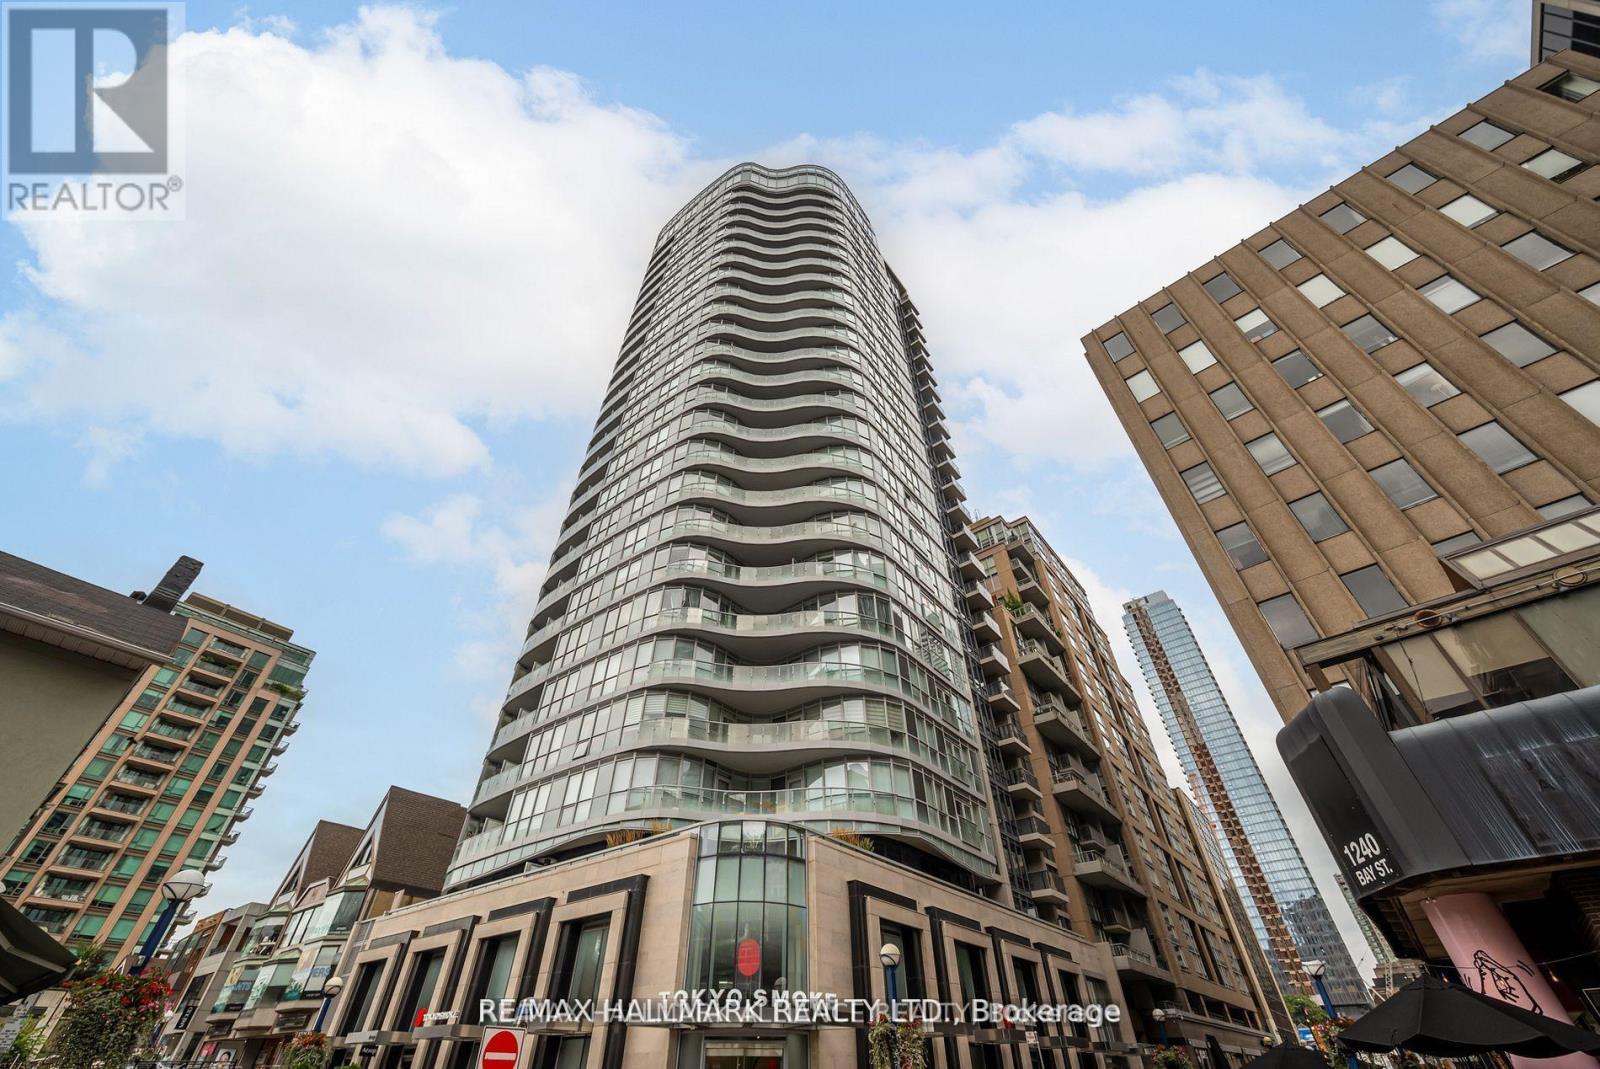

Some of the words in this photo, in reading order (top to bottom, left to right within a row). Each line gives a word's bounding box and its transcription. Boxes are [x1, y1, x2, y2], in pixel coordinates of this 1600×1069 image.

[1344, 832, 1381, 867] 1240
[1355, 865, 1377, 886] BAY
[1375, 858, 1394, 877] ST.
[658, 989, 743, 1009] TOKYO
[753, 989, 838, 1009] SMOKE
